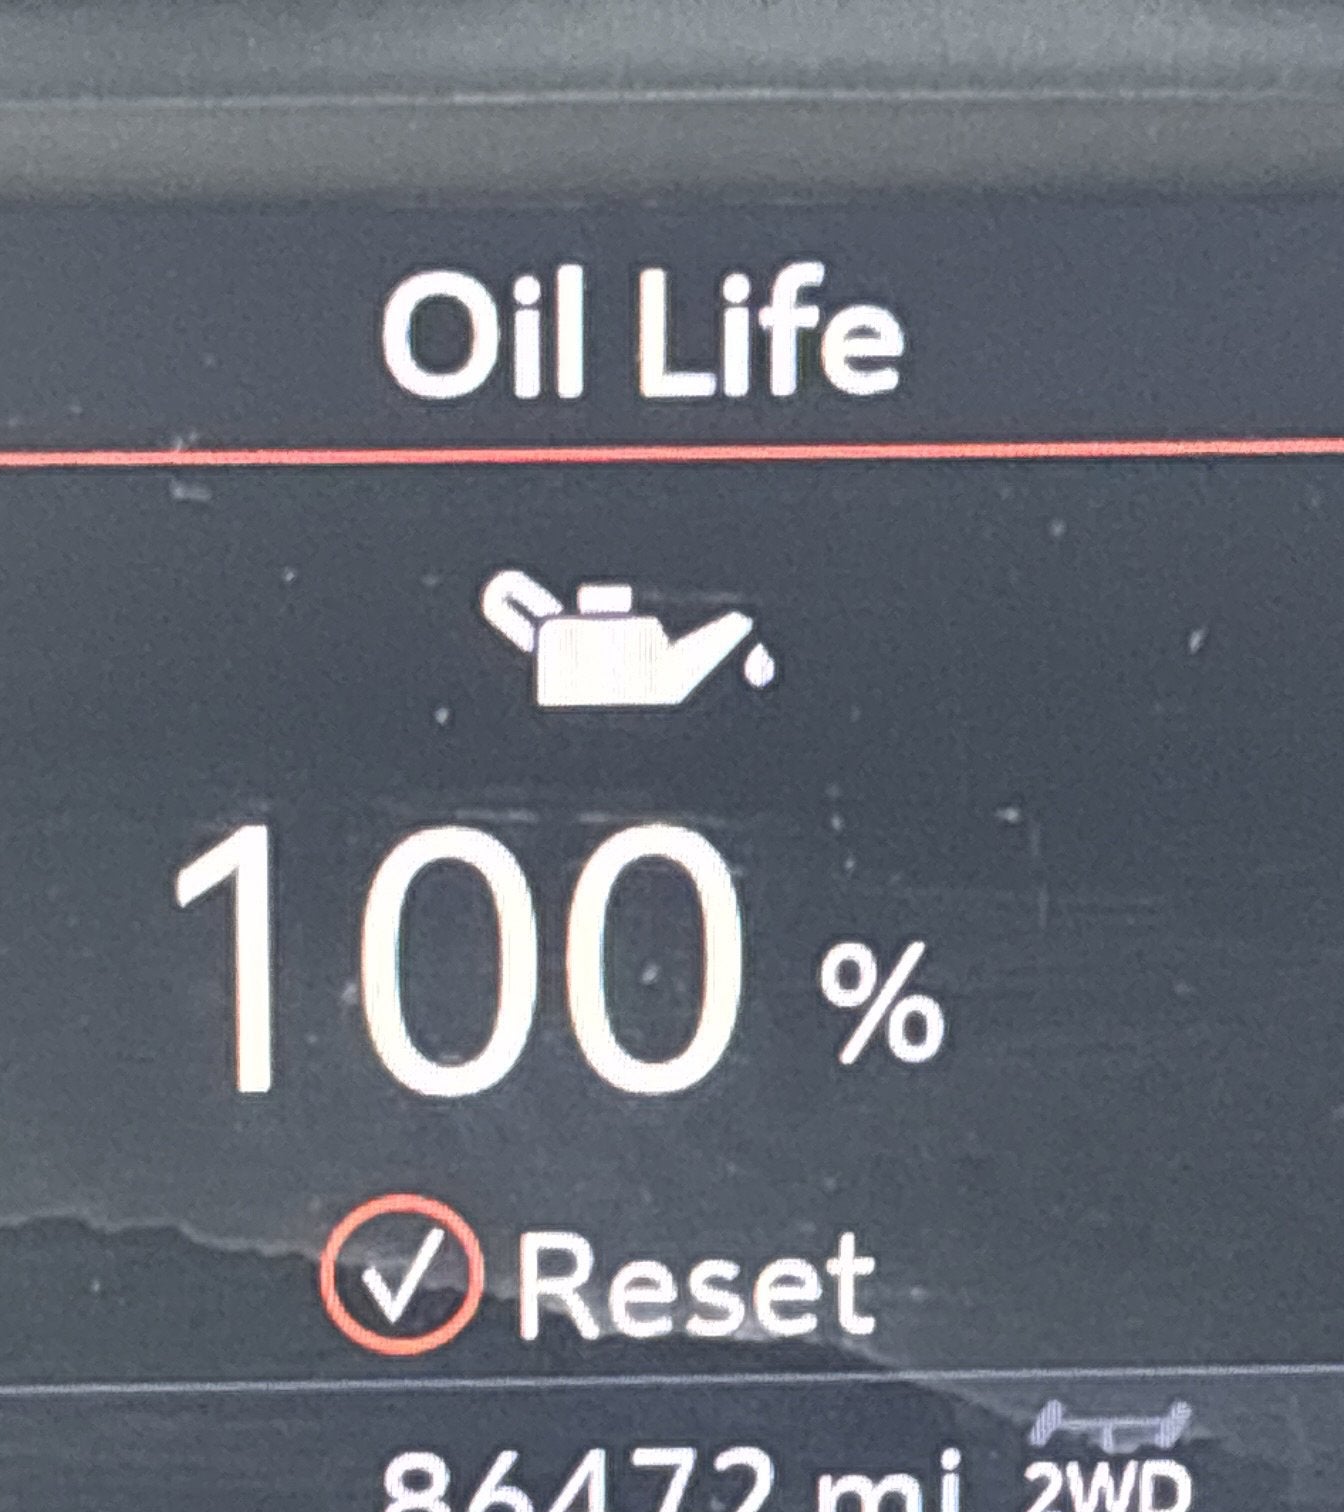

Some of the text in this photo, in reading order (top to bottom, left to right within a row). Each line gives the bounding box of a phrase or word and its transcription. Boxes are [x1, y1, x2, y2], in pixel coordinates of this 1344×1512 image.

[381, 261, 906, 400] Oil Life
[175, 822, 947, 1099] 100 %
[518, 1230, 877, 1342] Reset
